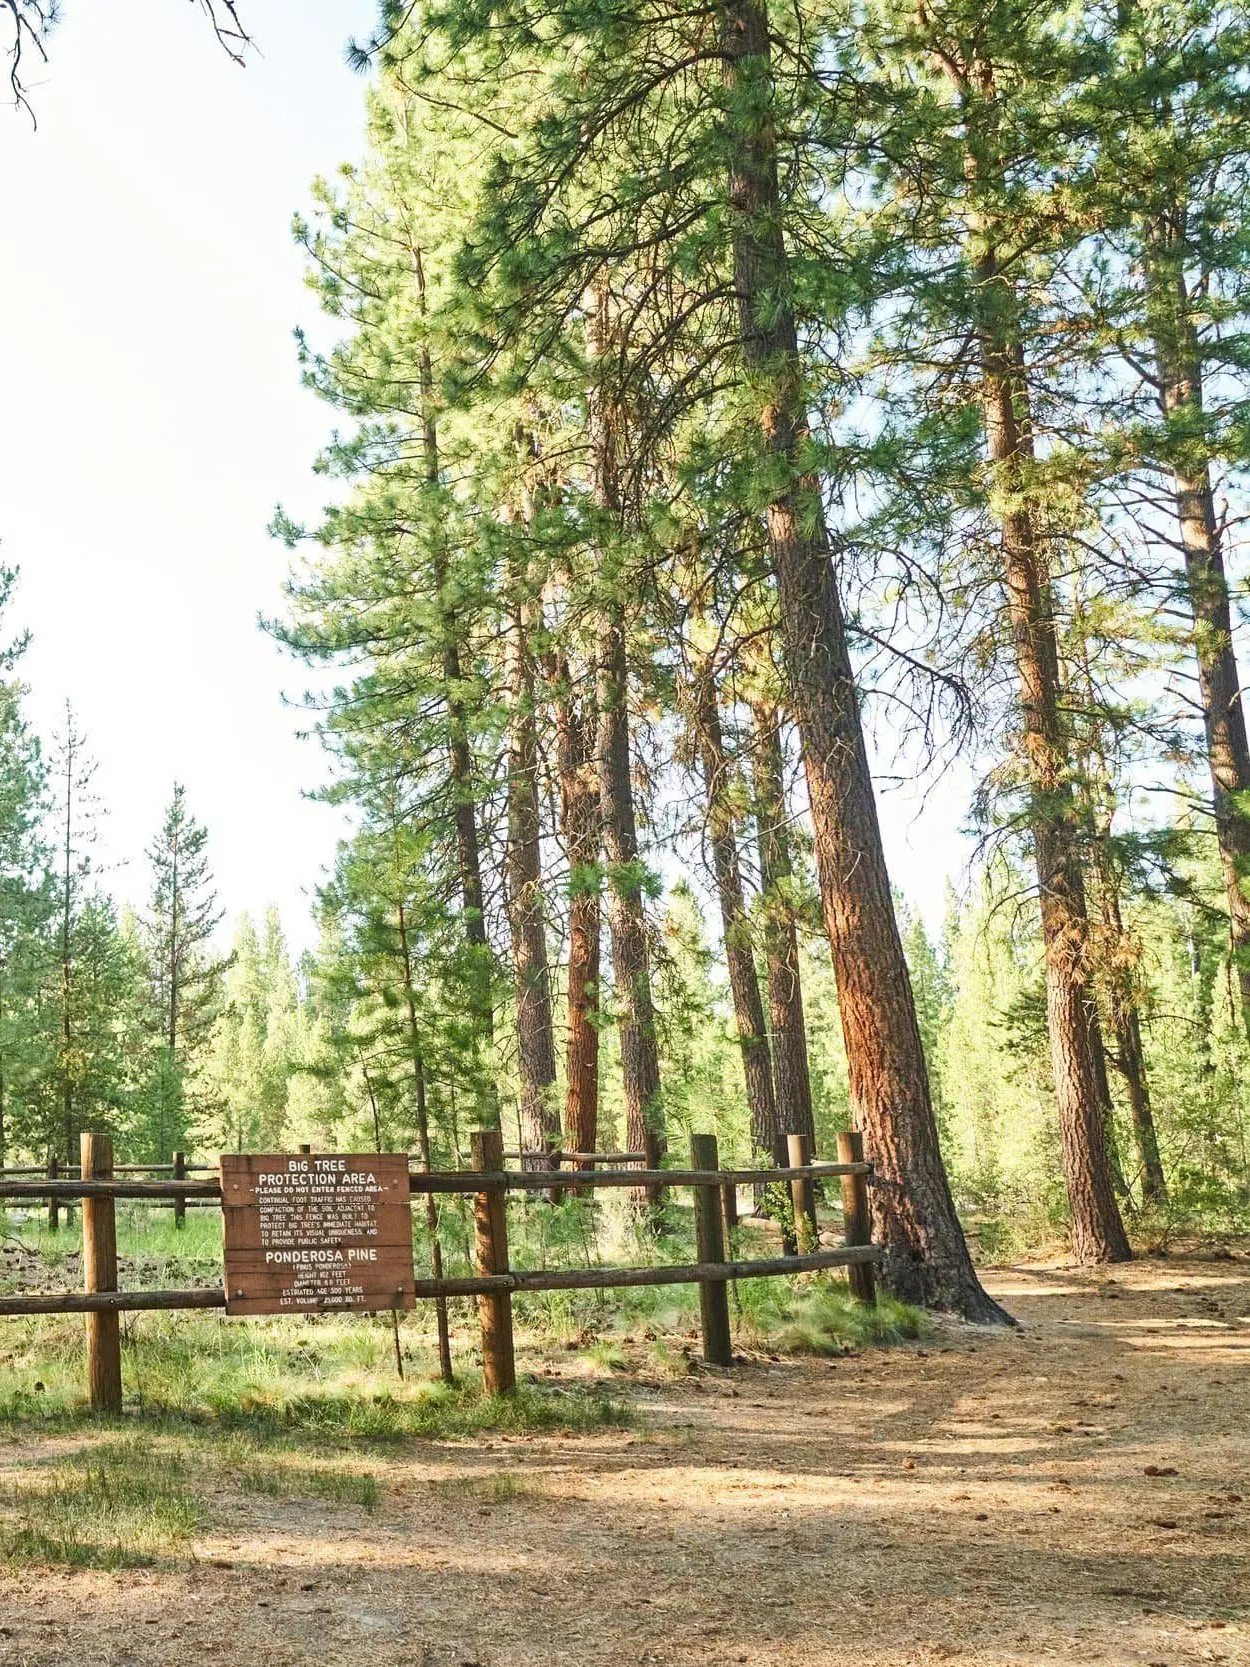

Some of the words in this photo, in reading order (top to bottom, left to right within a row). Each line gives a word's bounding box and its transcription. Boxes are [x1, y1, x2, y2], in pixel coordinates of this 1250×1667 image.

[289, 1160, 308, 1171] BIG
[314, 1160, 346, 1171] TREE
[259, 1173, 336, 1185] PROTECTION
[342, 1173, 376, 1184] AREA
[341, 1212, 357, 1220] BUILT
[271, 1238, 294, 1246] PROVIDE
[266, 1250, 343, 1263] PONDEROSA
[348, 1248, 377, 1261] PINE
[331, 1270, 346, 1278] FEET
[282, 1288, 313, 1296] ESTIMATED
[317, 1287, 327, 1295] AGE
